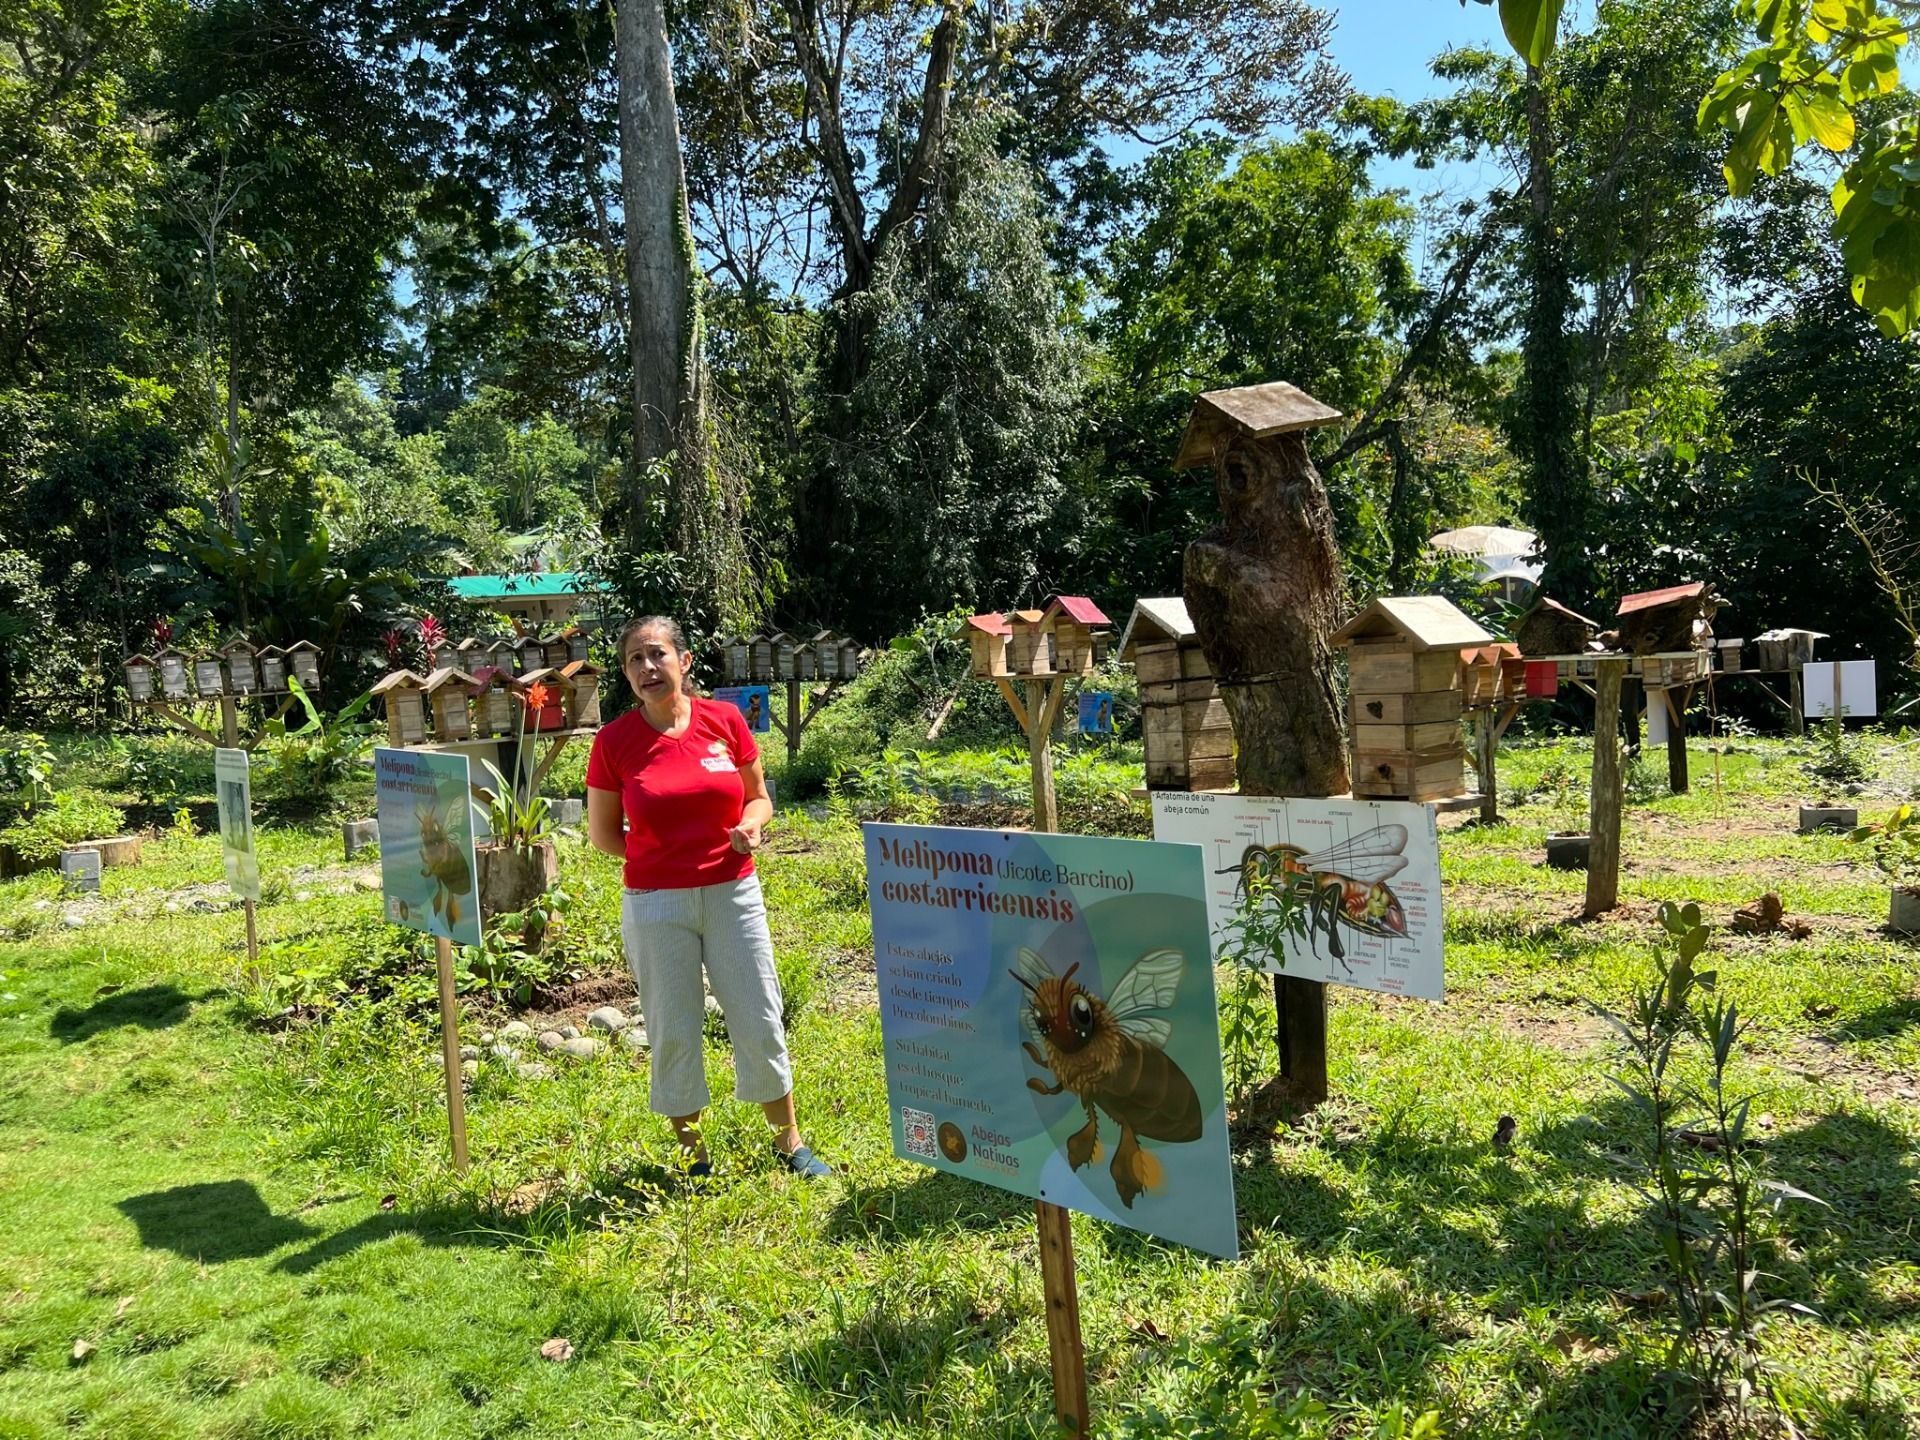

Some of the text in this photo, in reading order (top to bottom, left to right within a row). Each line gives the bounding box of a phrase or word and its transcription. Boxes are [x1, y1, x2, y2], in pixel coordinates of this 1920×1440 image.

[1163, 804, 1210, 815] abeja común
[1191, 793, 1200, 802] de
[1201, 794, 1215, 803] una
[878, 837, 1134, 892] Melipona (Jicote Barcino)
[882, 880, 1074, 923] costarricensis
[887, 942, 953, 967] Estas abejas
[889, 965, 962, 987] se han criado
[891, 984, 970, 1010] desde tiempos
[896, 1039, 909, 1052] Su
[897, 1062, 964, 1087] es el bosque
[900, 1081, 941, 1100] tropical
[971, 1124, 1011, 1147] Abejas
[973, 1143, 1020, 1168] Nativas
